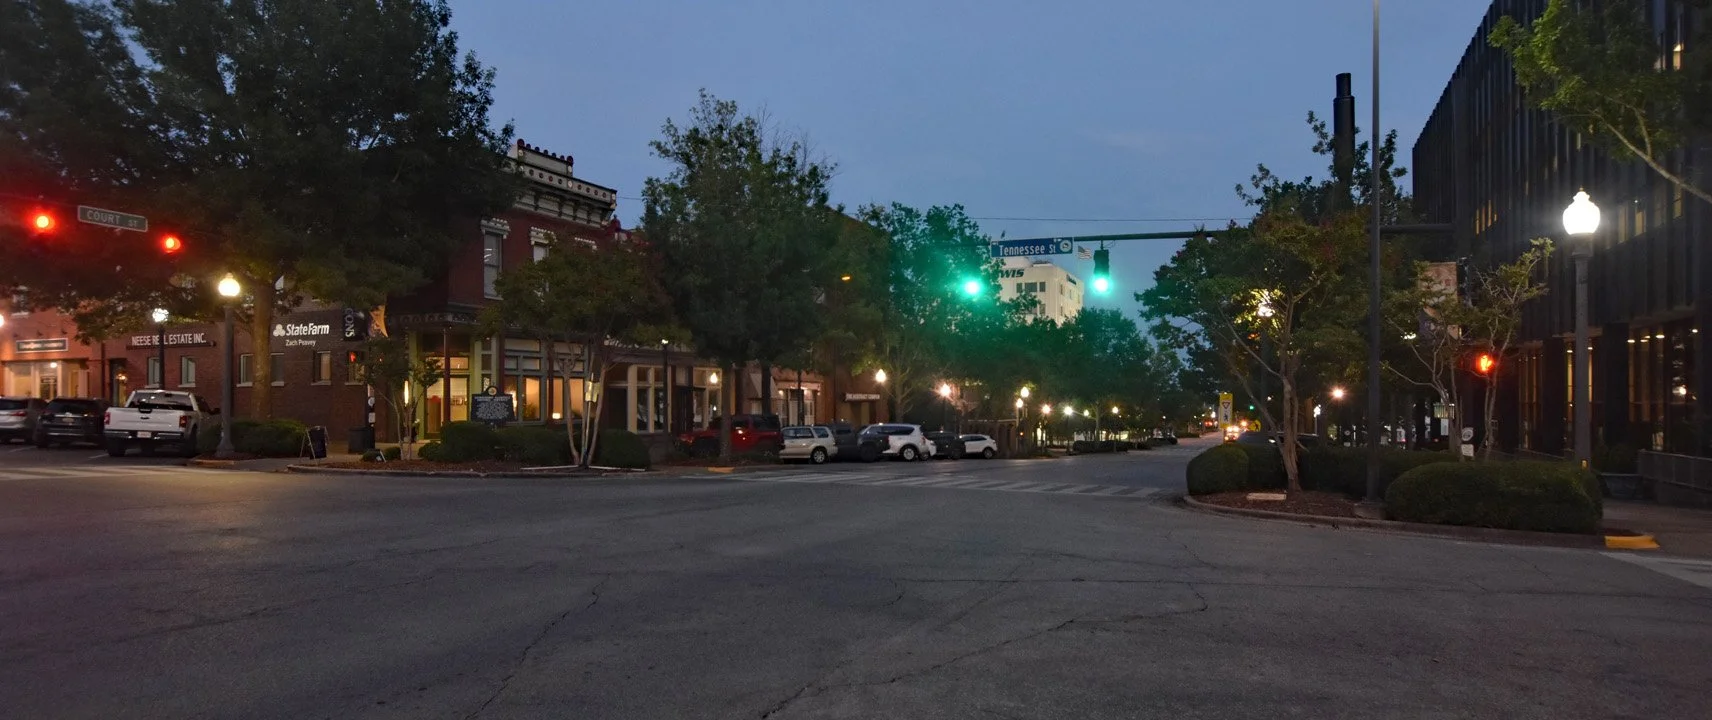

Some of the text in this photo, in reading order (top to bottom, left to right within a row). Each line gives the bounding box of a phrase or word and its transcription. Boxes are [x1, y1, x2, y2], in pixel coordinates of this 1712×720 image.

[87, 210, 139, 228] COURT ST
[999, 243, 1056, 256] Tennessee St
[131, 332, 207, 346] NEESE REL ESTATE INC.
[285, 339, 298, 347] Zach
